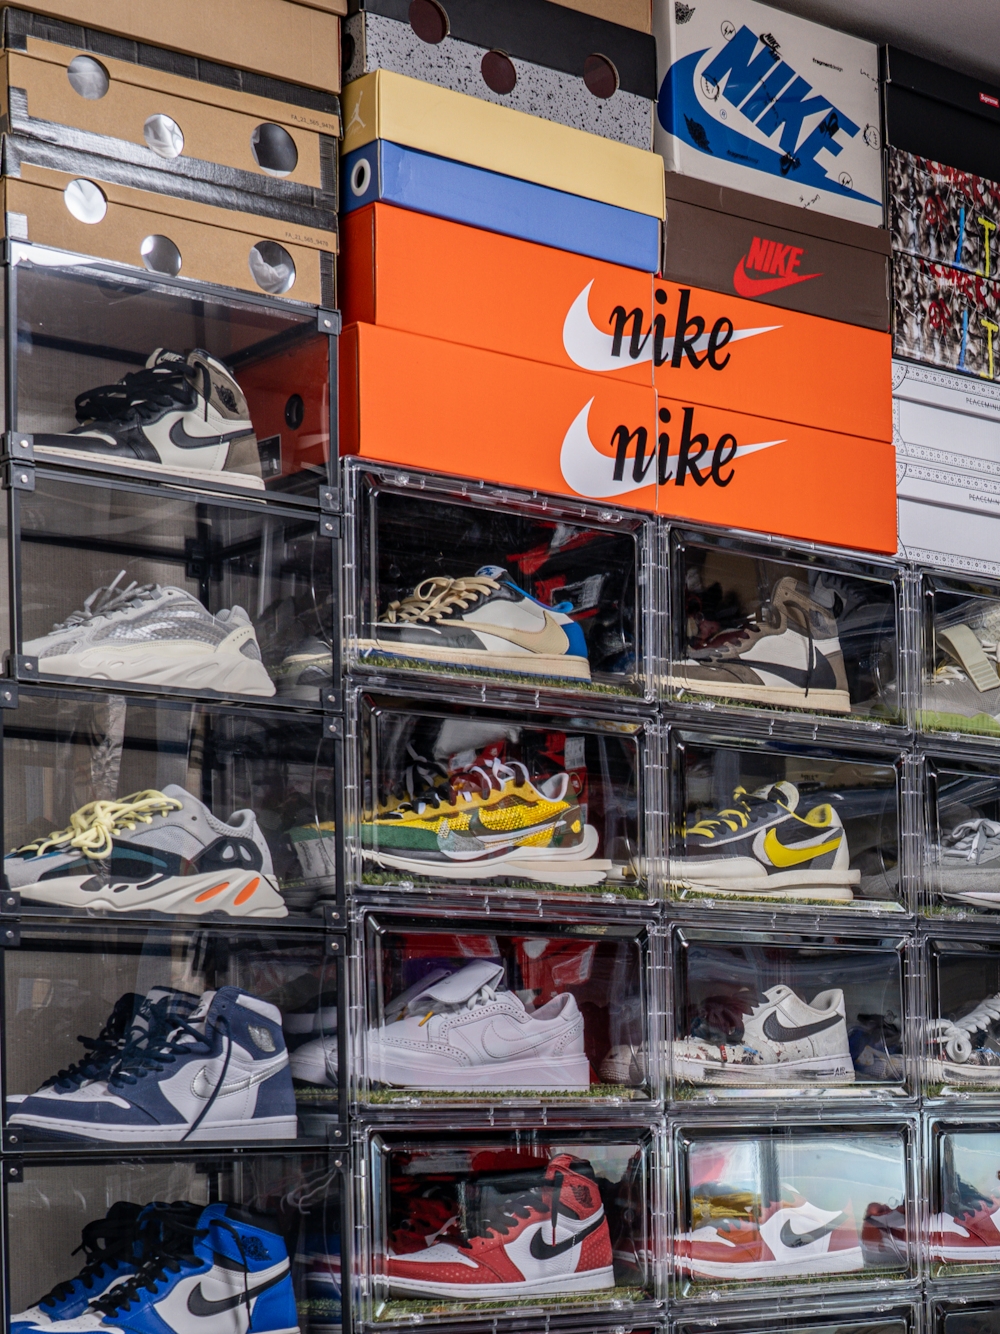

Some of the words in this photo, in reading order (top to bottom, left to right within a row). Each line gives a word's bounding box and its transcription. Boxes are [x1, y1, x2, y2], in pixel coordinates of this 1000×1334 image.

[765, 33, 781, 50] NIKE
[701, 24, 861, 172] NIKE
[746, 236, 804, 278] NIKE
[609, 288, 734, 371] nike
[610, 407, 738, 487] nike
